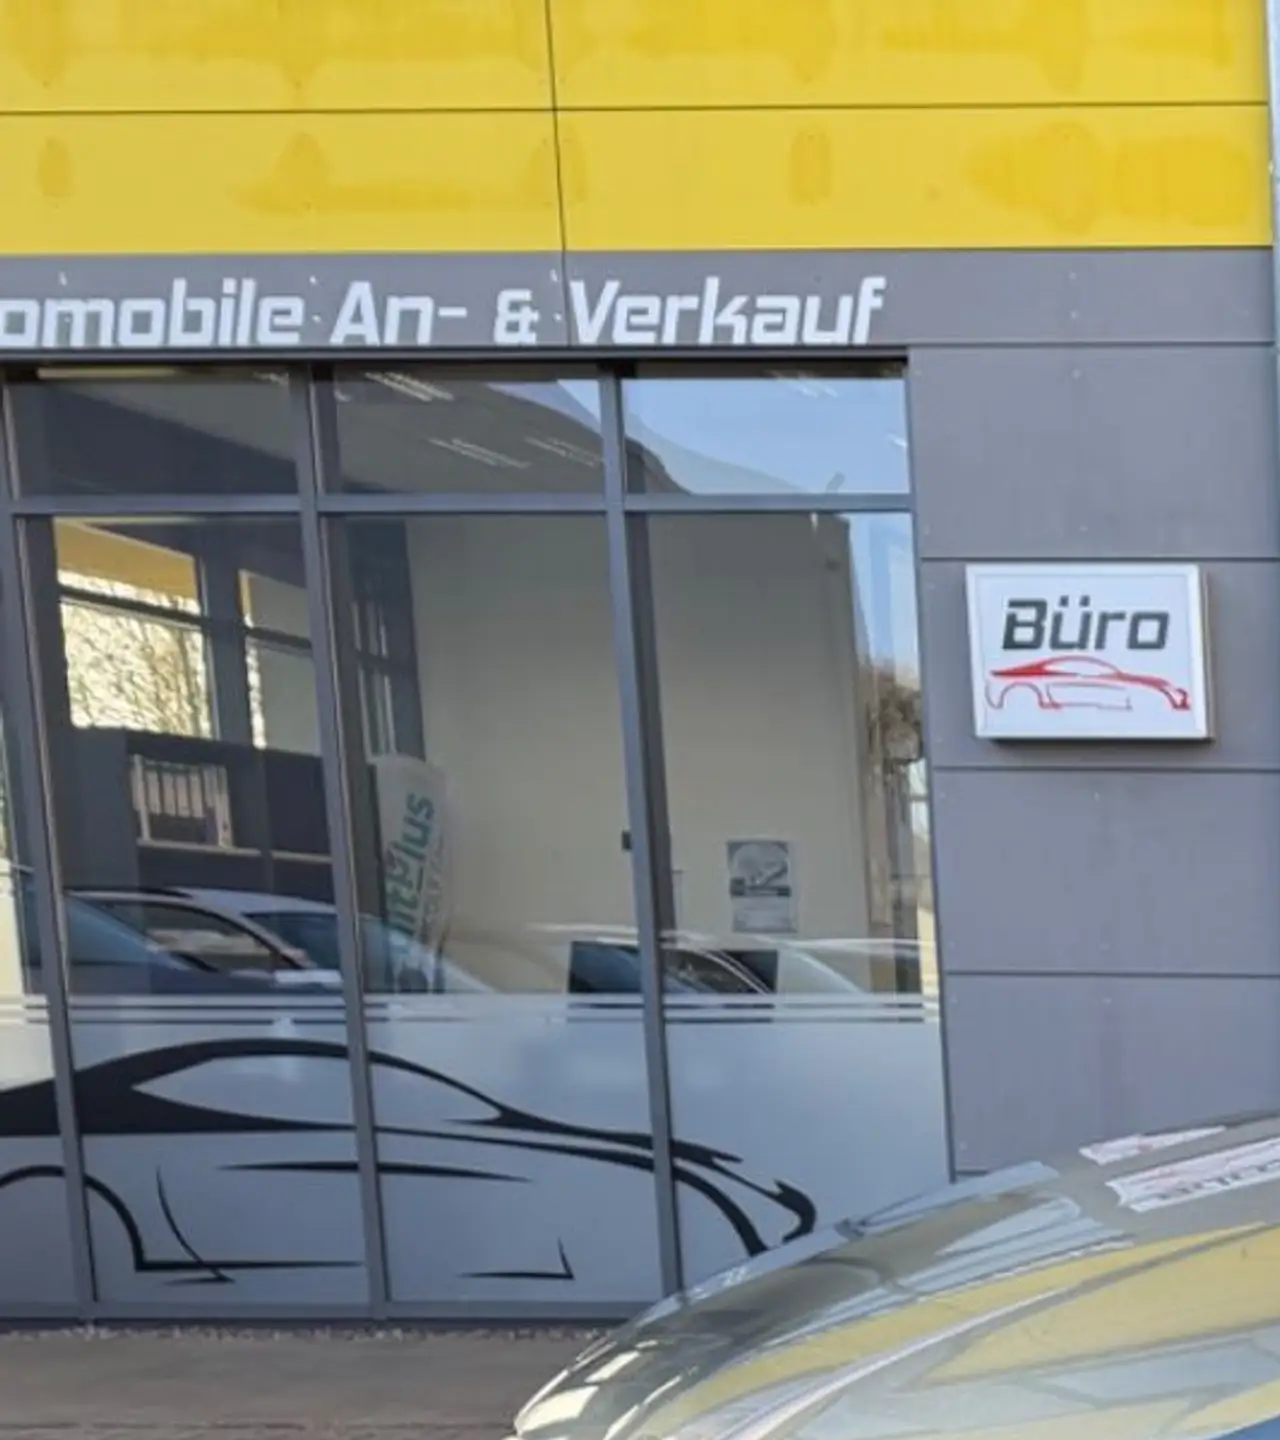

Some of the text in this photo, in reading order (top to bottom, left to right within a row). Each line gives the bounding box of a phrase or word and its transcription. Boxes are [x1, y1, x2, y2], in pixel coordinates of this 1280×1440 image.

[330, 281, 467, 345] An-
[494, 288, 540, 345] &
[568, 276, 888, 346] Verkauf
[1002, 595, 1169, 650] Büro
